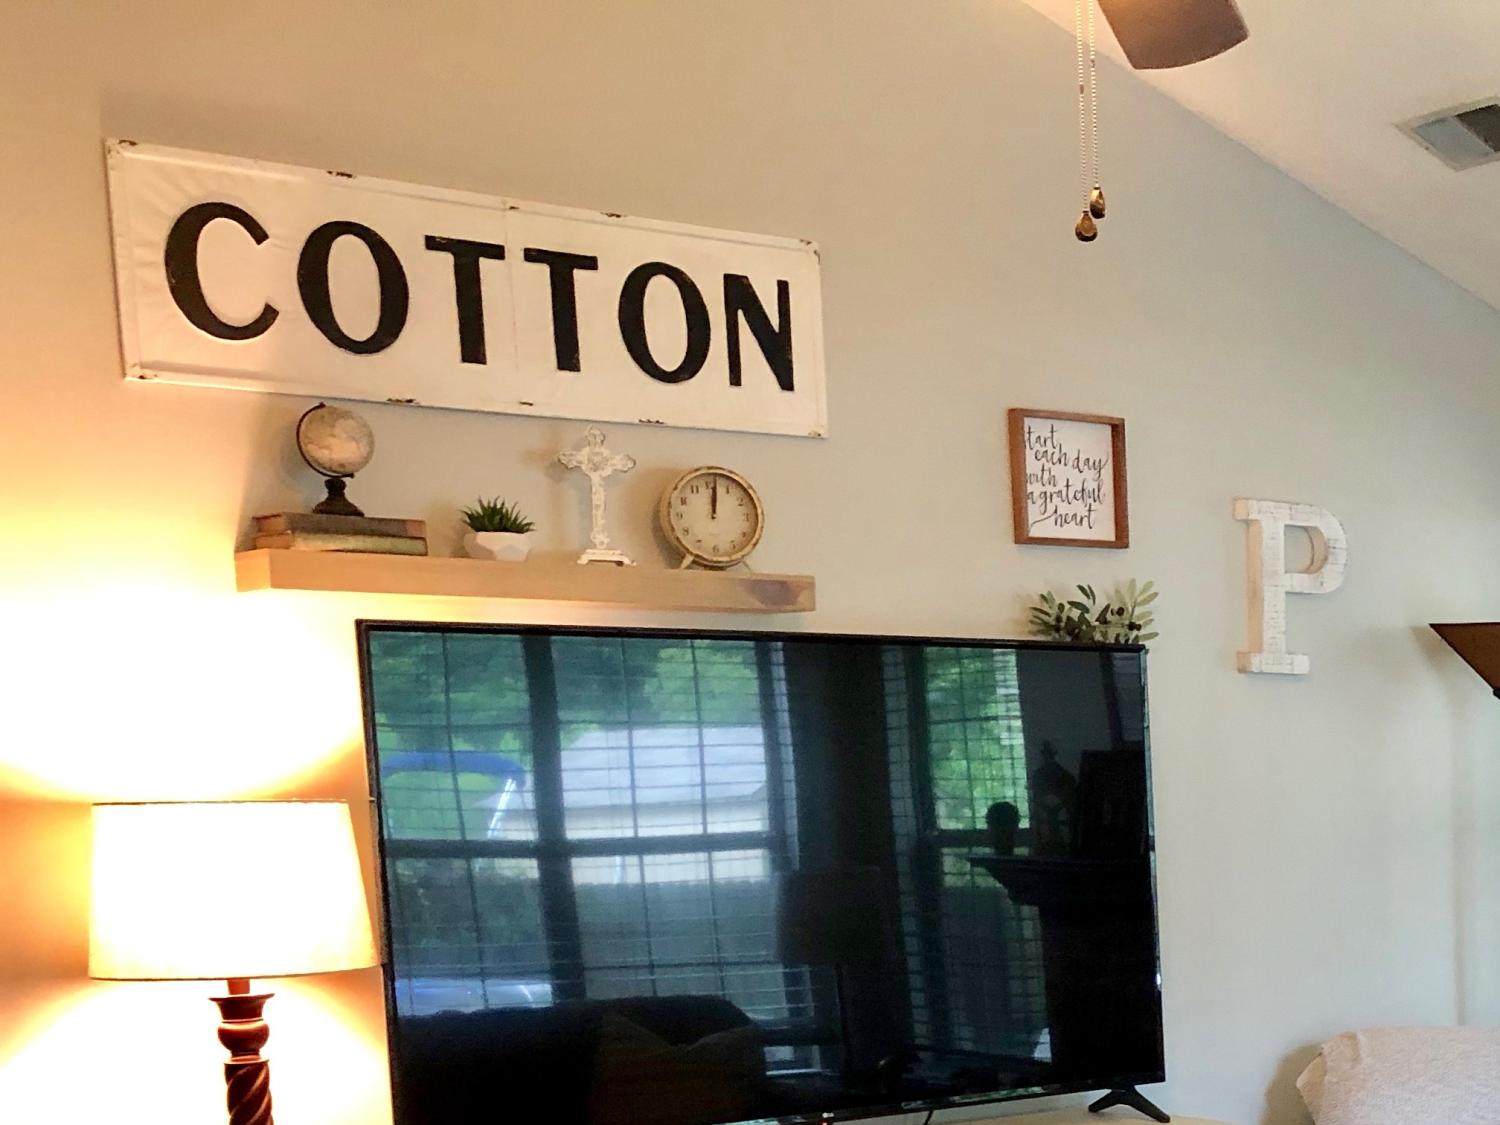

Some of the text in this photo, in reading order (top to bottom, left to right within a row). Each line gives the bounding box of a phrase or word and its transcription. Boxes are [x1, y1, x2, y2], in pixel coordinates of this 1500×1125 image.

[164, 201, 795, 393] COTTON
[1024, 423, 1057, 450] tart
[1034, 443, 1109, 481] each day
[1031, 503, 1096, 529] heart
[1040, 478, 1106, 516] grateful
[1232, 497, 1347, 675] P
